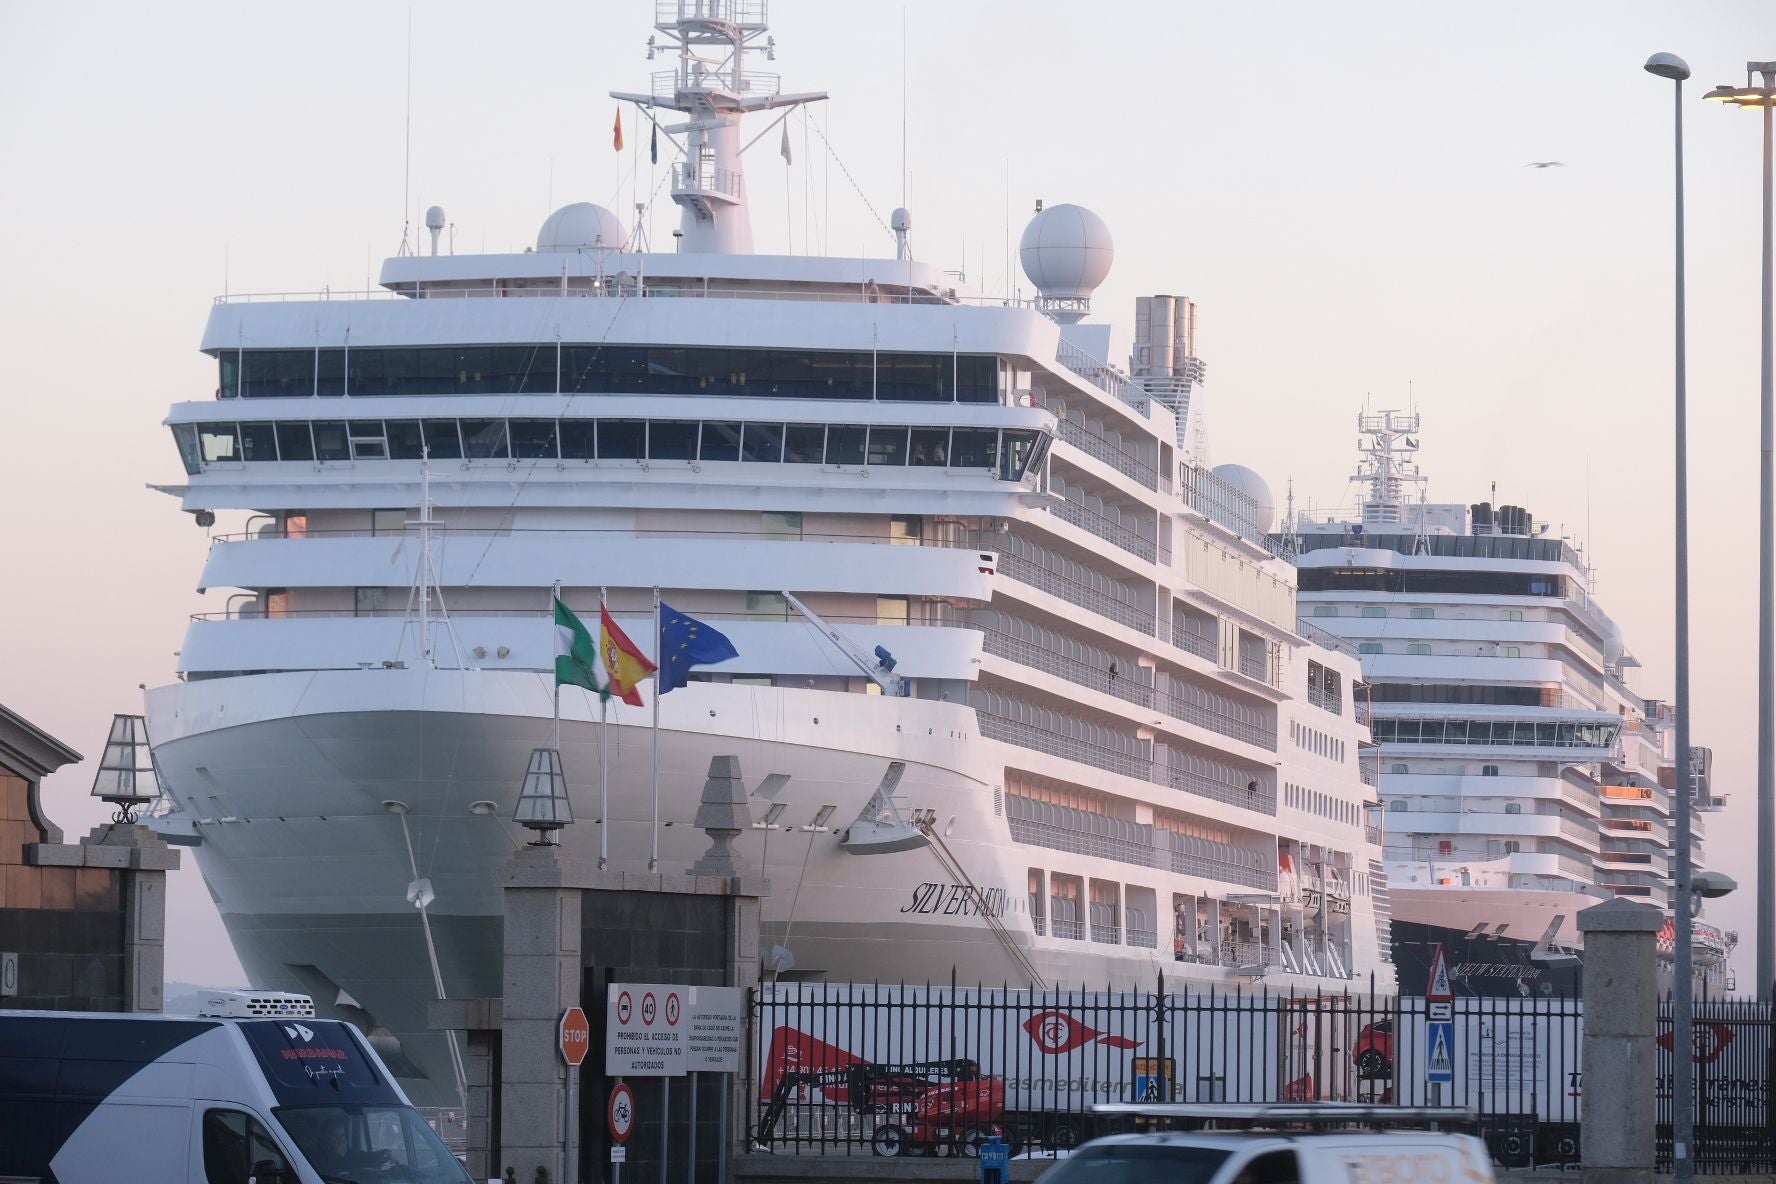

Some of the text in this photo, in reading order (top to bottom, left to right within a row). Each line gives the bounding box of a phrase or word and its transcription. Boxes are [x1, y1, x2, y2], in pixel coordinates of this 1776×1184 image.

[901, 882, 974, 915] SILVER
[644, 1003, 654, 1015] 40
[564, 1030, 587, 1042] STOP
[617, 1032, 679, 1041] PROHIBIDO EL ACCESO DE
[614, 1047, 682, 1055] PERSONAS Y VEHICULOS NO
[631, 1061, 665, 1070] AUTORIZADOS
